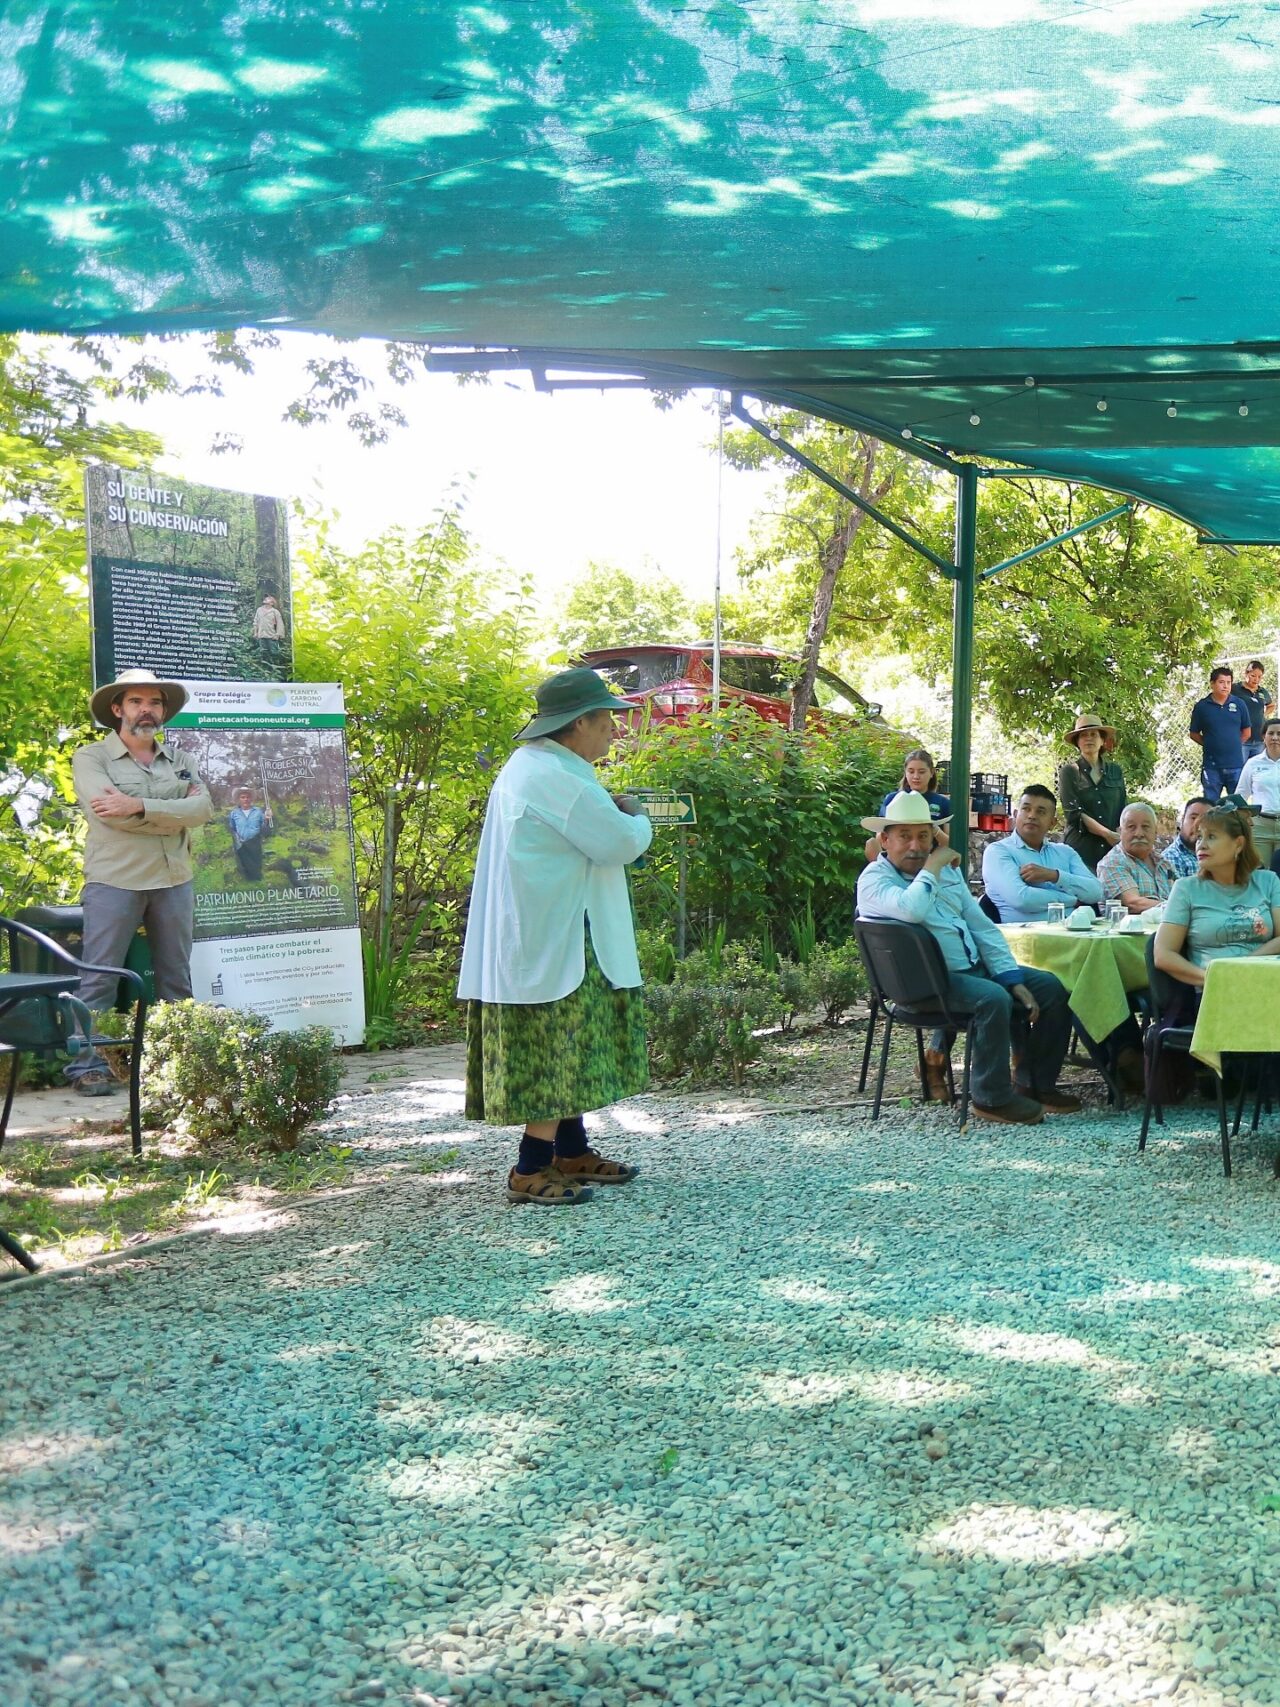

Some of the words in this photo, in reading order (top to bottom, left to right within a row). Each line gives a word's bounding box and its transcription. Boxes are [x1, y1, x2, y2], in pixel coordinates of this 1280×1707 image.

[108, 481, 125, 498] SU
[130, 486, 171, 506] GENTE
[174, 492, 183, 506] Y
[108, 505, 127, 522] SU
[130, 509, 228, 536] CONSERVACIÓN
[198, 716, 310, 725] planetacarbononeutral.org
[196, 890, 264, 906] PATRIMONIO
[267, 885, 339, 901] PLANETARIO
[276, 940, 310, 948] combatir
[246, 952, 280, 960] climático
[297, 947, 332, 957] pobreza:
